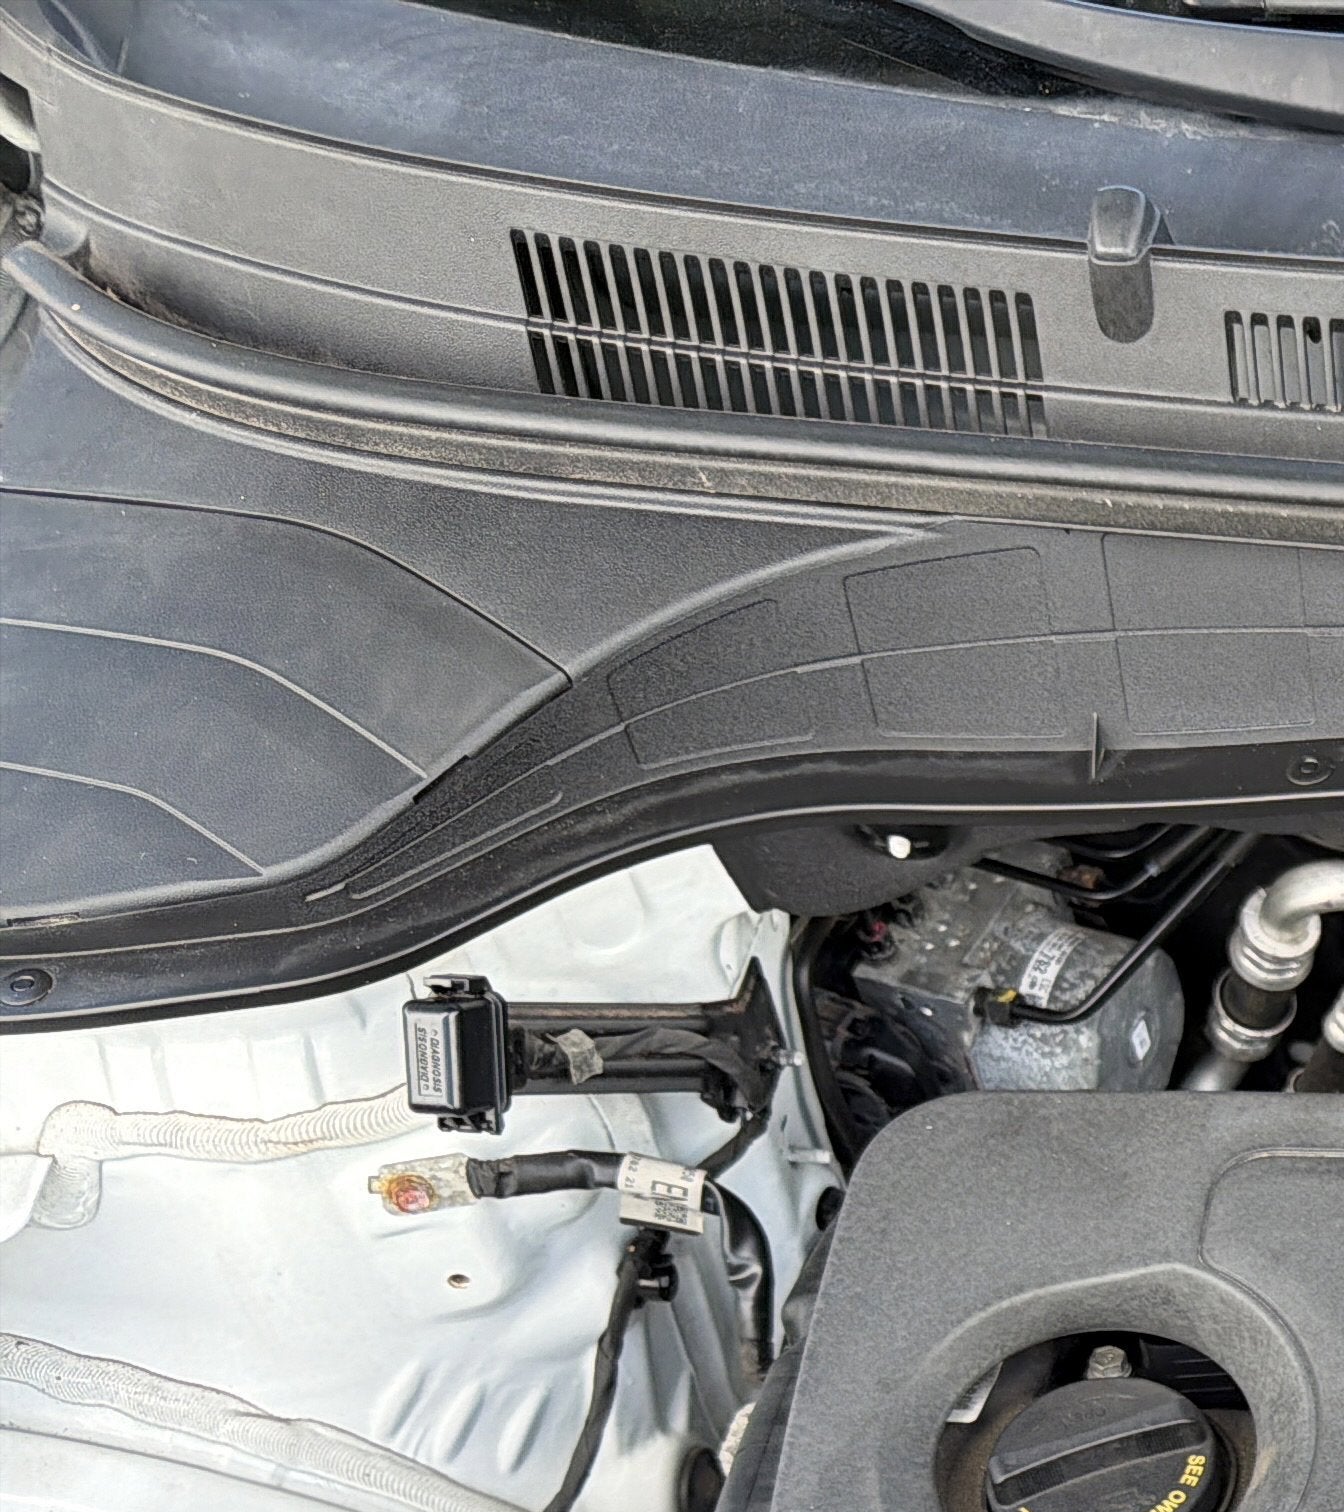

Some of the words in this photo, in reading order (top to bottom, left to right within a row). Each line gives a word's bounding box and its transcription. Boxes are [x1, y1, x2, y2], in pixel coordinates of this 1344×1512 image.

[417, 1027, 430, 1083] DIAGNOSIS
[431, 1037, 444, 1093] DIAGNOSIS
[1177, 1454, 1206, 1487] SEE
